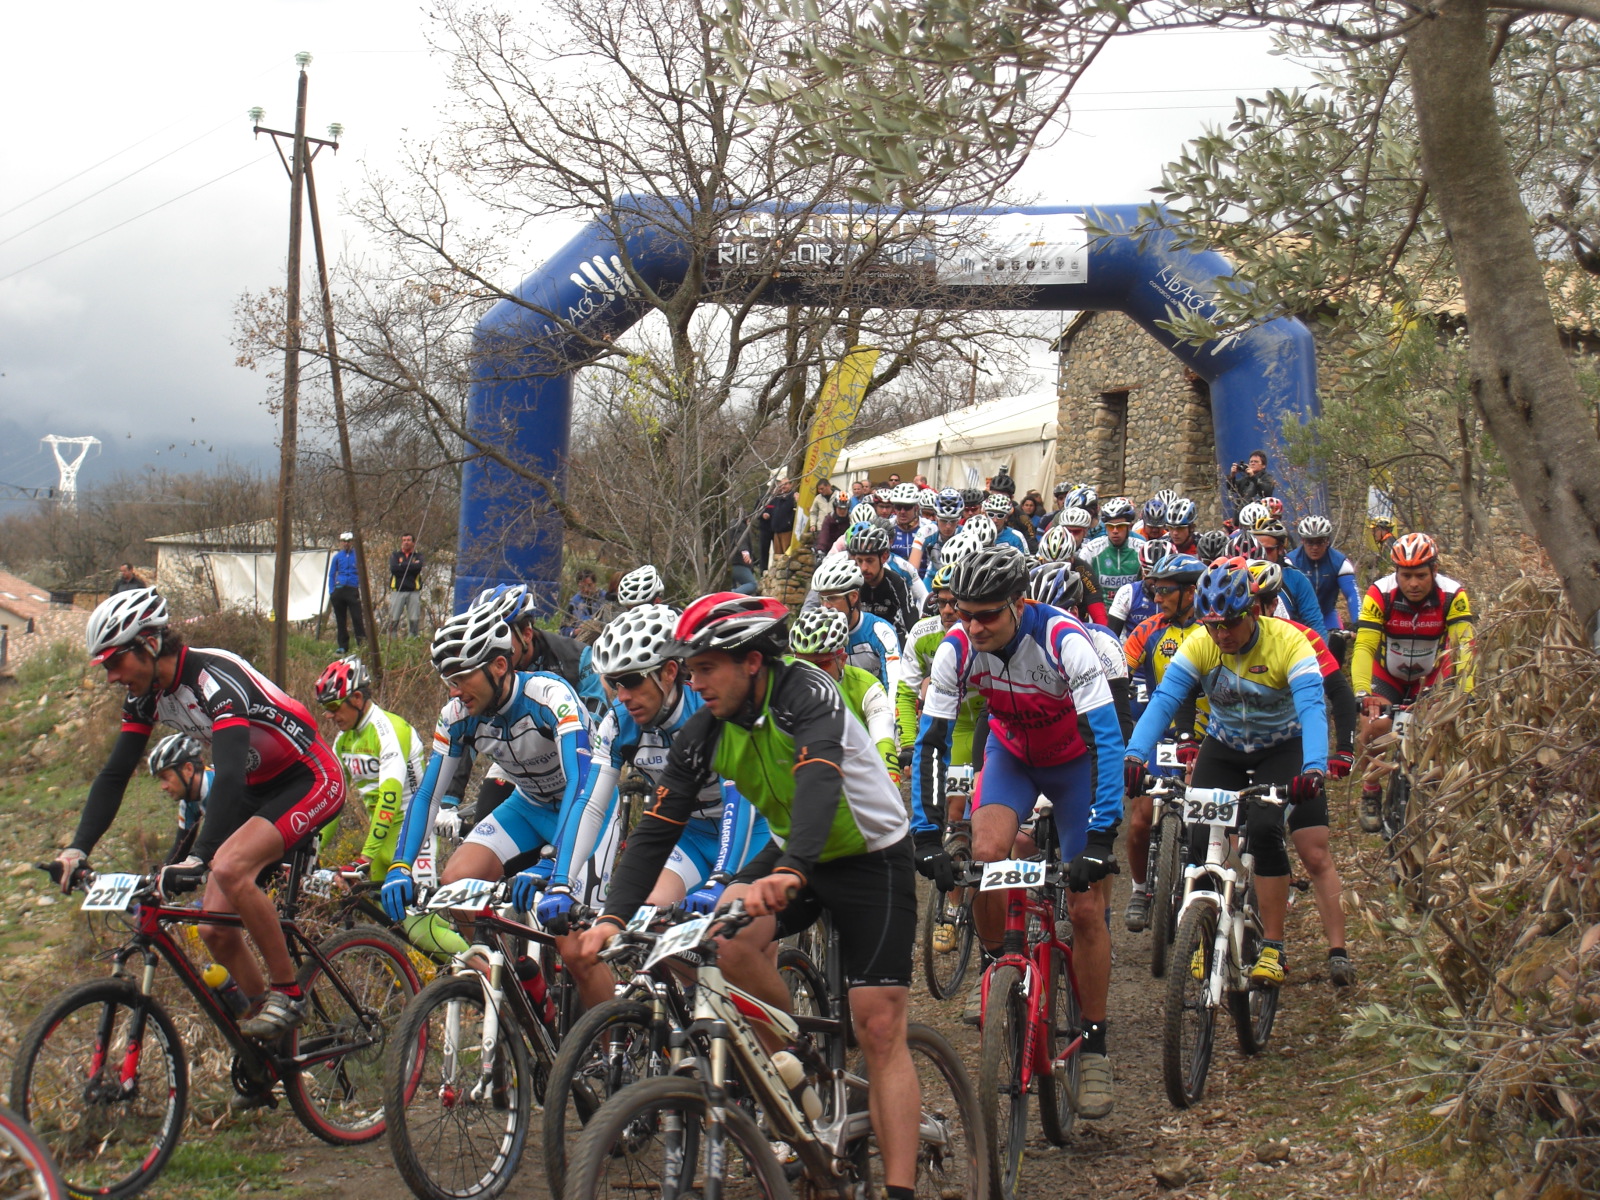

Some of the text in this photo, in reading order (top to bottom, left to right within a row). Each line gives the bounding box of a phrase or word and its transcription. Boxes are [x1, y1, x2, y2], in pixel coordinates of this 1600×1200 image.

[635, 755, 663, 766] CLUB
[307, 798, 328, 820] Motor
[1187, 800, 1234, 822] 269
[984, 870, 1042, 888] 280
[86, 887, 131, 906] 227
[1023, 1020, 1038, 1070] SUPER
